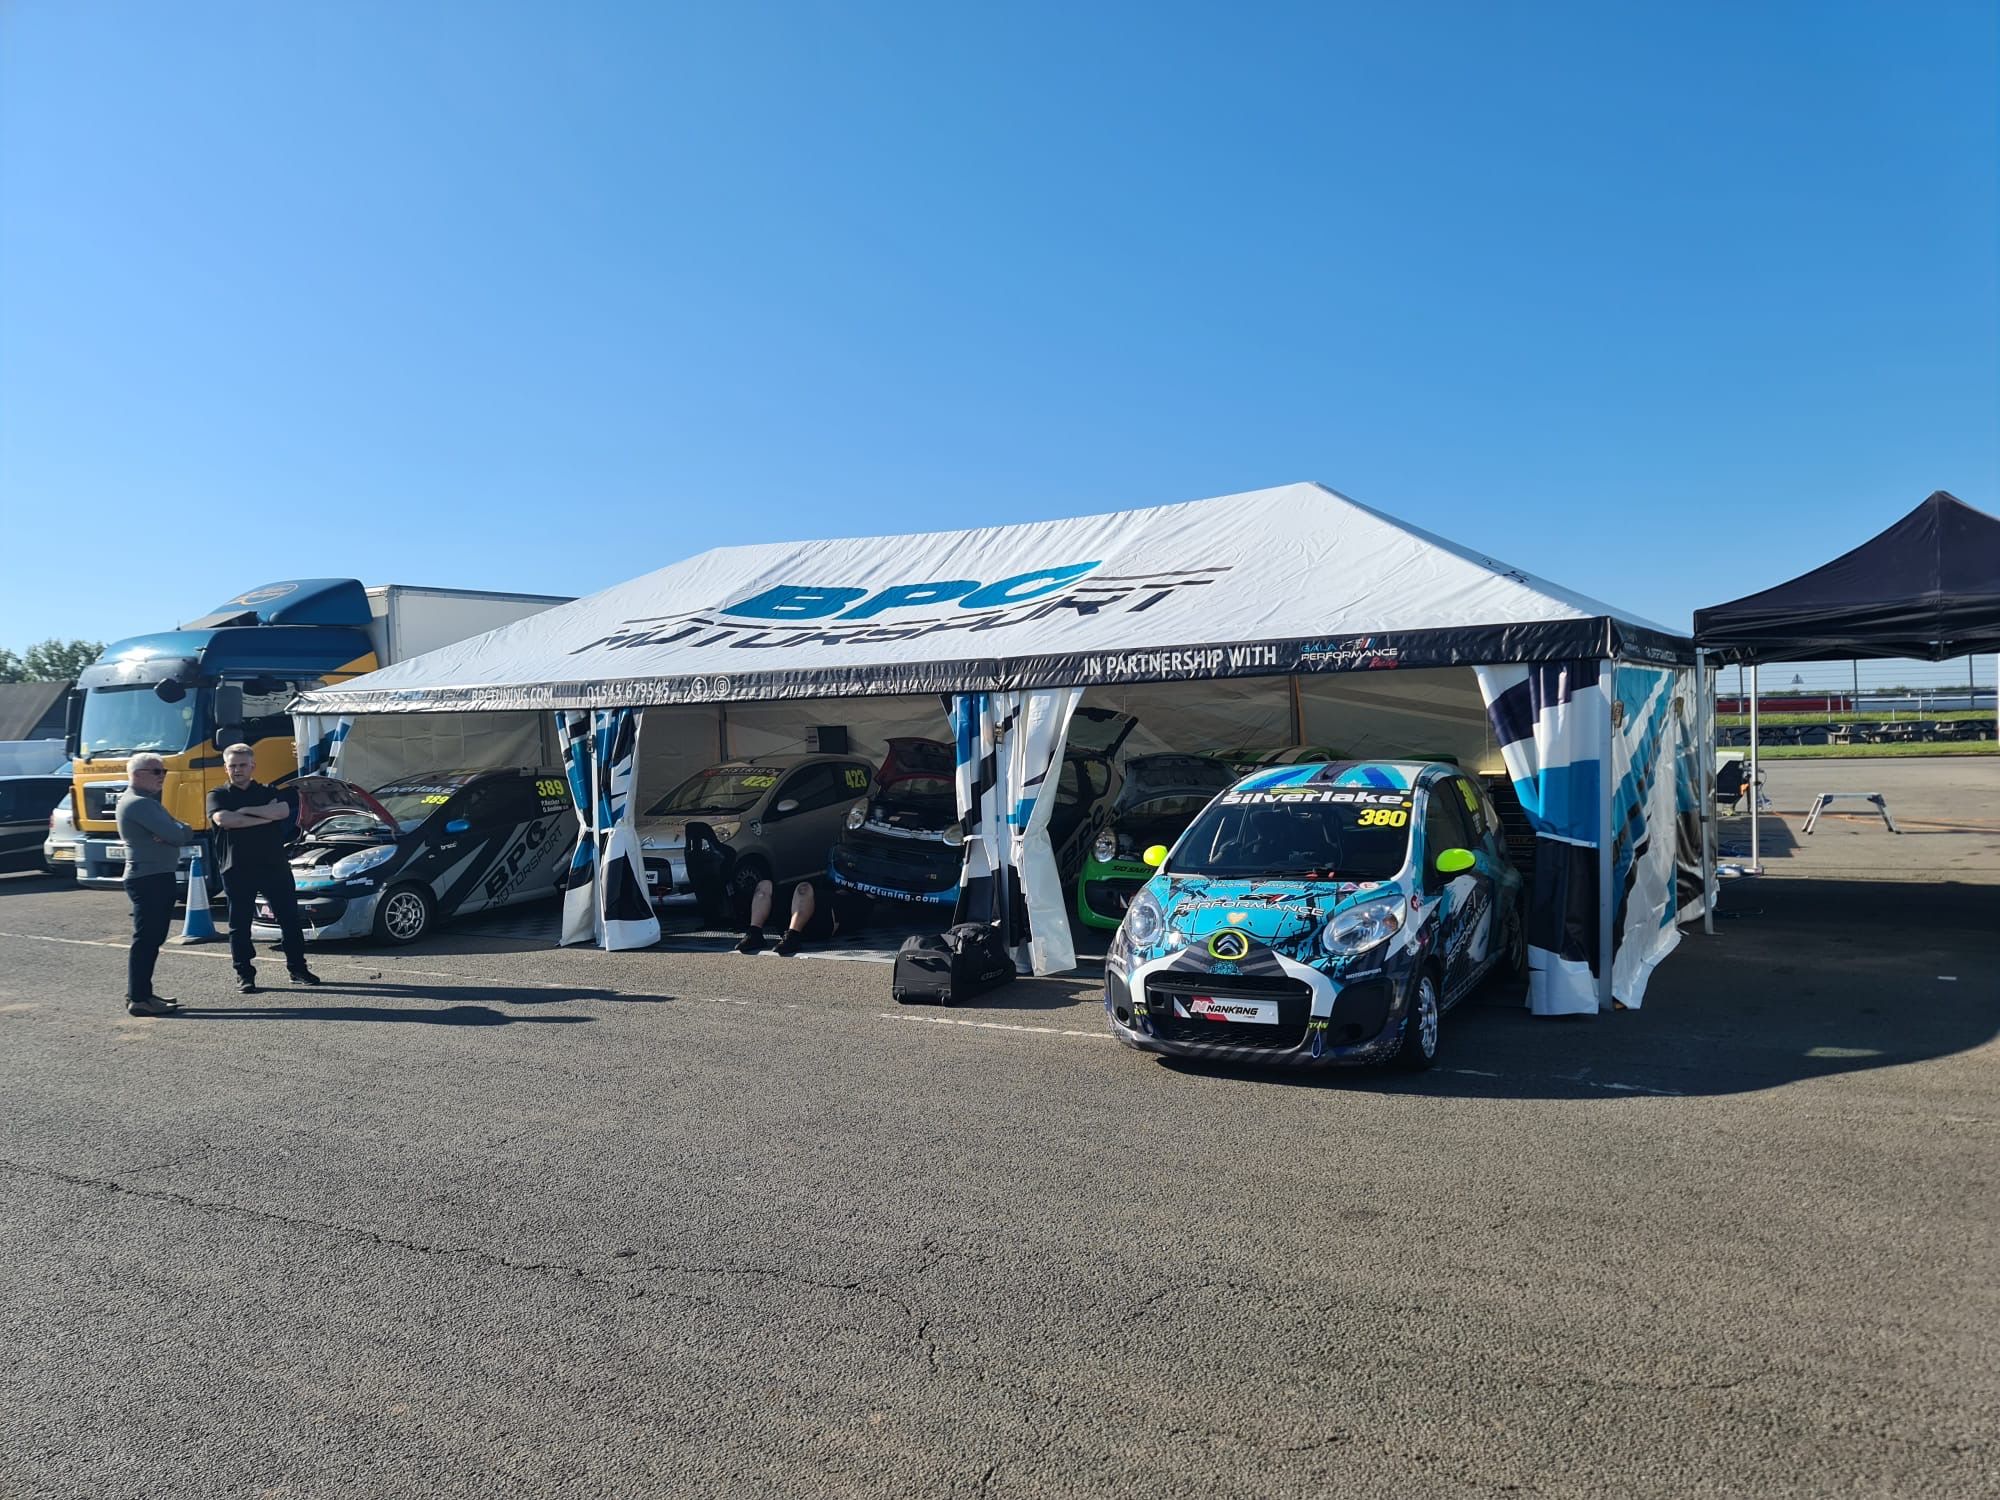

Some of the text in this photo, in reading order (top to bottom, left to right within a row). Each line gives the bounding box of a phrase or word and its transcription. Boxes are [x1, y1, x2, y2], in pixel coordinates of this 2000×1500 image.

[719, 560, 1101, 620] BPC
[1301, 643, 1337, 653] GALA
[1301, 648, 1398, 661] PERFORMANCE
[1084, 645, 1276, 676] IN PARTNERSHIP WITH
[587, 683, 622, 700] 01543
[719, 766, 777, 775] DISTRIGO
[845, 769, 867, 788] 423
[535, 780, 564, 797] 389
[741, 776, 777, 788] 423
[421, 795, 449, 804] 389
[1358, 809, 1407, 827] 380
[484, 820, 547, 900] BPC
[491, 826, 563, 908] MOTORSPORT
[834, 876, 940, 903] www.BPCtuning.com
[1174, 900, 1325, 917] PERFORMANCE
[1206, 1004, 1259, 1016] NANKANG
